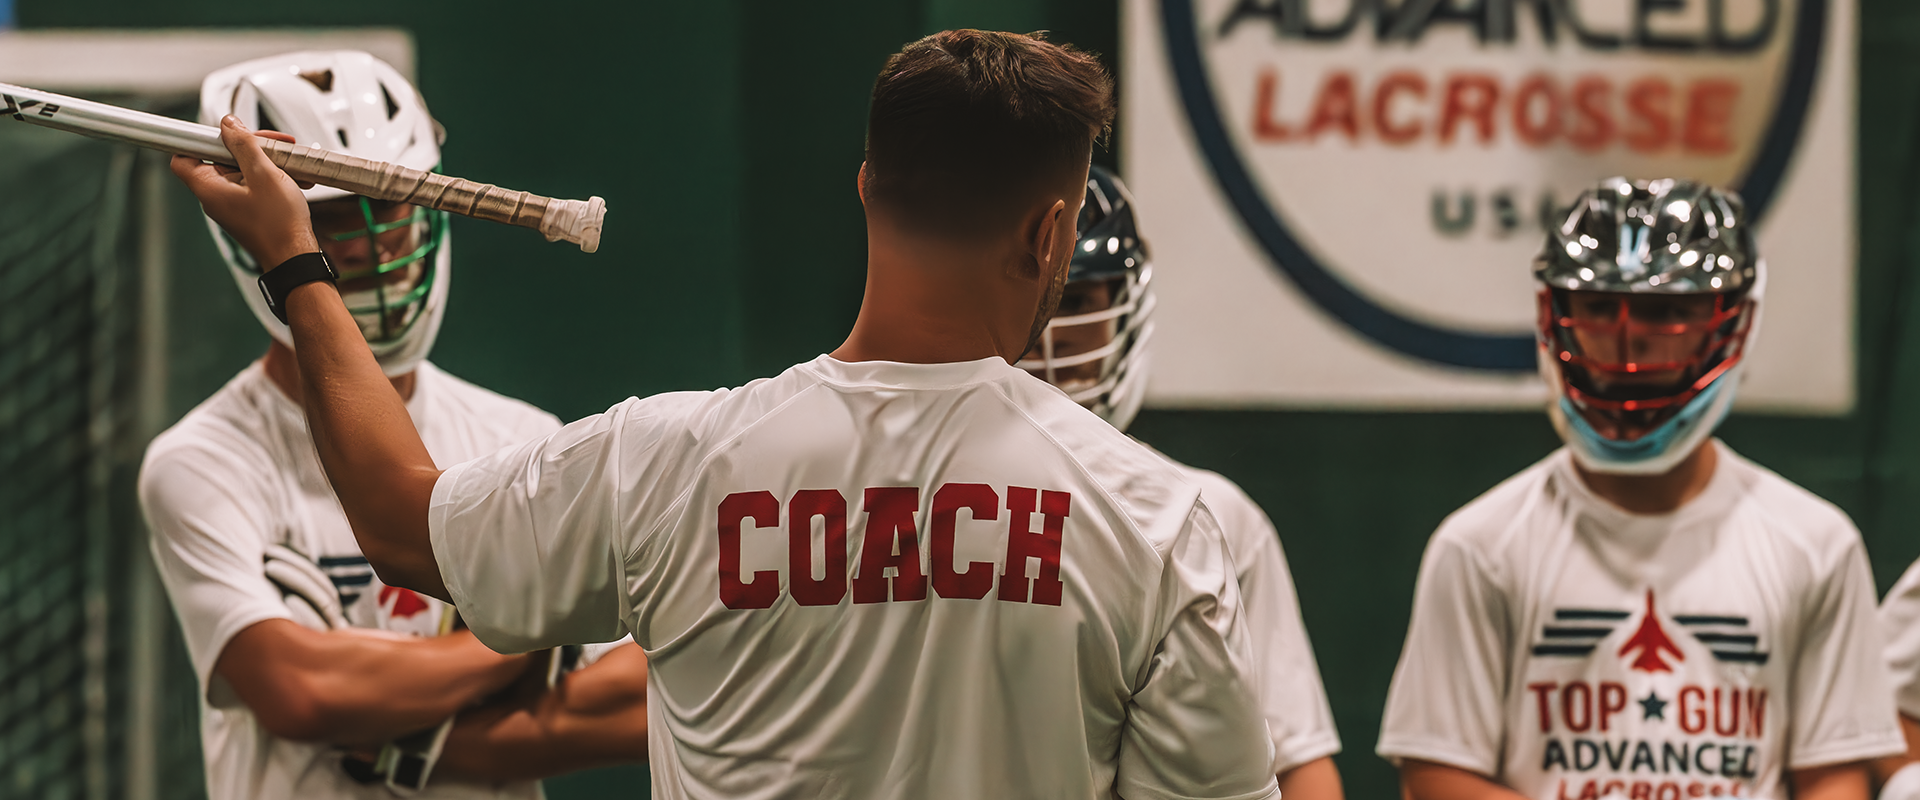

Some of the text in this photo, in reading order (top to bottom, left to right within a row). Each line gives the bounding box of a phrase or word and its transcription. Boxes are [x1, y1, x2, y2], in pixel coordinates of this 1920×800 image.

[1217, 0, 1780, 51] ADVANCED
[1252, 66, 1743, 155] LACROSSE
[1432, 188, 1556, 237] US
[717, 482, 1072, 611] COACH
[1528, 682, 1768, 739] TOP GUN
